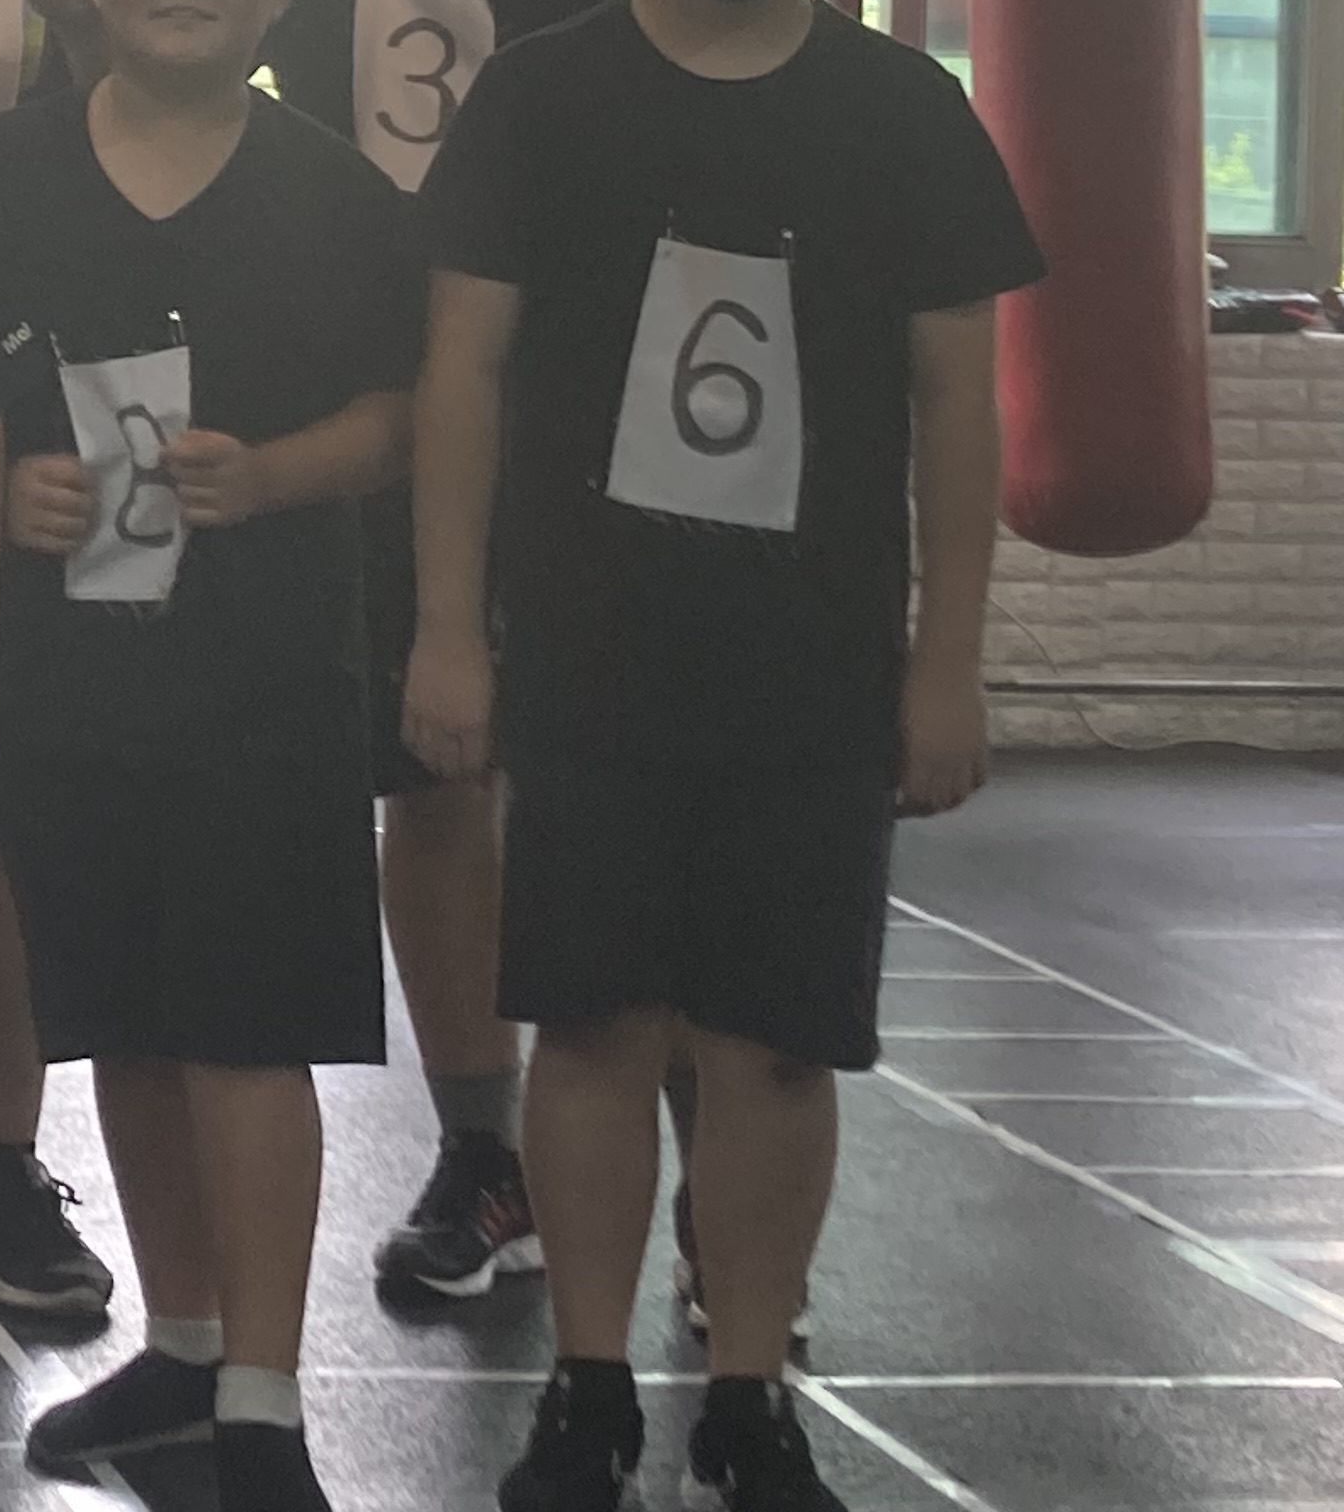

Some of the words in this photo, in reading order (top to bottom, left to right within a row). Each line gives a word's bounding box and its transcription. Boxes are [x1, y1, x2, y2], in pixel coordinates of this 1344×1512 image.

[376, 18, 456, 144] 3
[671, 299, 769, 456] 6
[115, 403, 178, 549] 8
